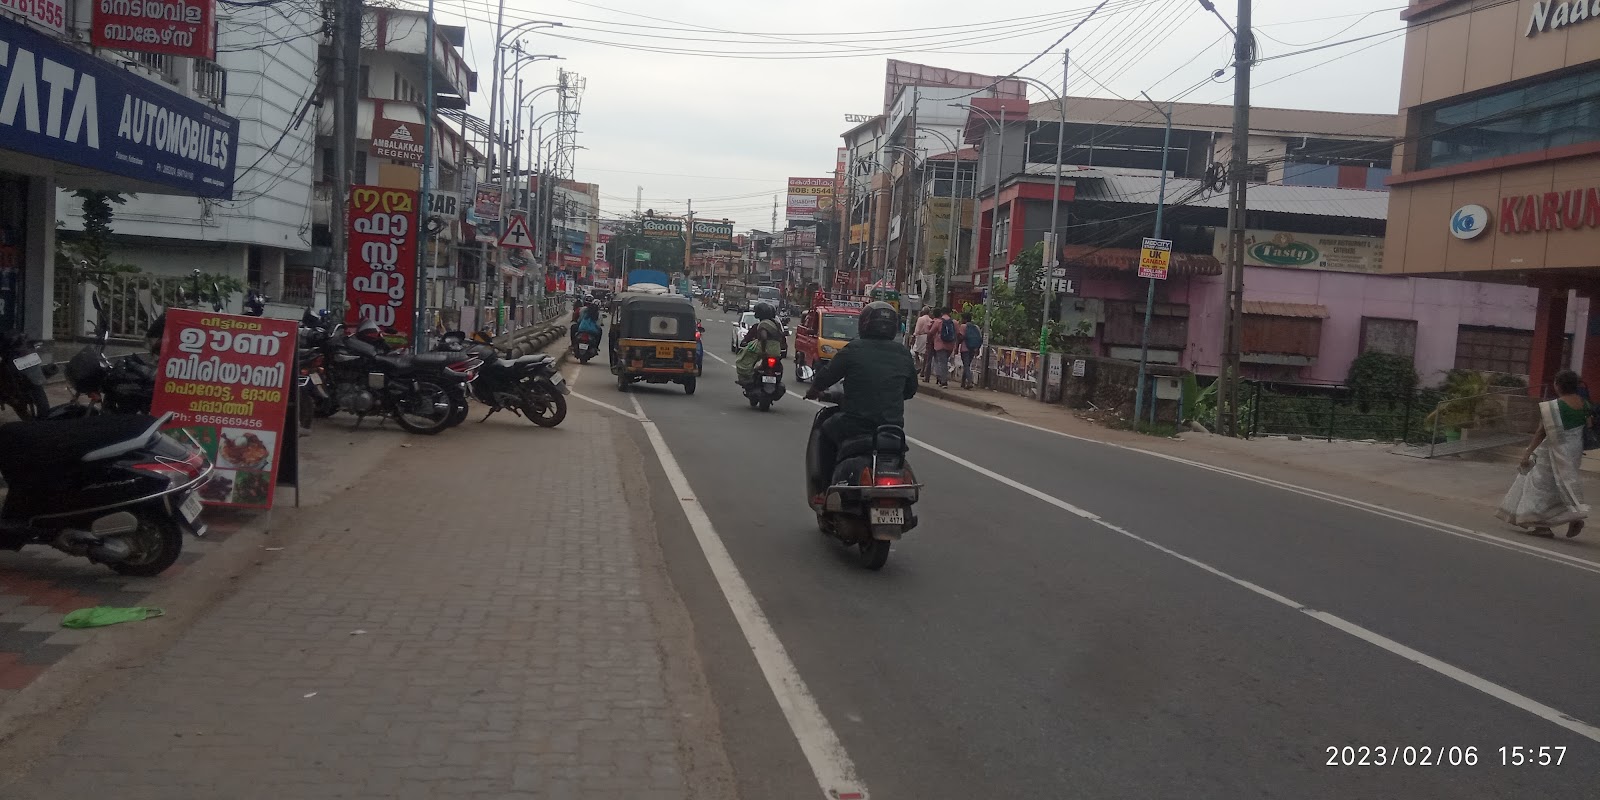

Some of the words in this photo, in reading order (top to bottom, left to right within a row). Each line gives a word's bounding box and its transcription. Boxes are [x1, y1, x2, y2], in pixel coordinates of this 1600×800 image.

[0, 40, 99, 149] ATA
[117, 93, 229, 170] AUTOMOBILES
[372, 138, 425, 153] AMBALAKKAR
[377, 148, 422, 160] REGENCY
[1149, 250, 1162, 259] UK
[1262, 245, 1308, 260] Tasty
[1142, 258, 1166, 266] CANADA
[178, 328, 288, 356] ഊണ്
[165, 353, 285, 388] ബിരിയാണി
[171, 412, 191, 422] Ph:
